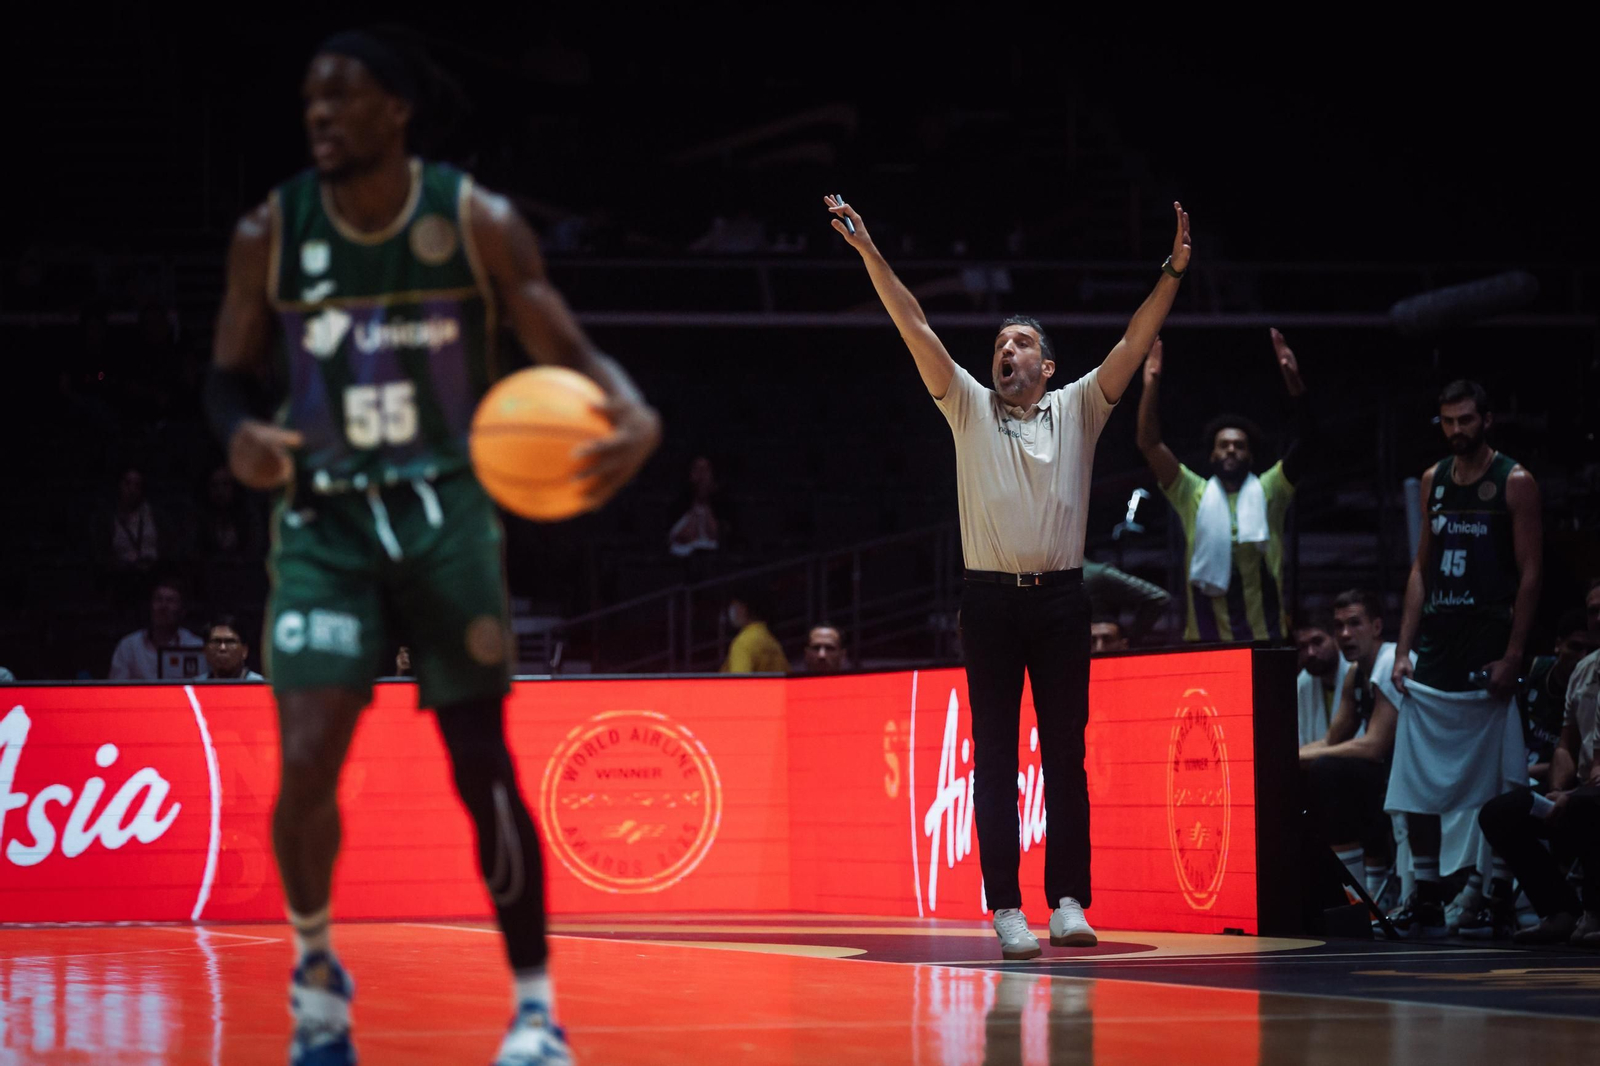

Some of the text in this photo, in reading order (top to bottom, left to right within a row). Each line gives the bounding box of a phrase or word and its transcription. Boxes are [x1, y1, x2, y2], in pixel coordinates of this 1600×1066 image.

[342, 380, 418, 450] 55
[1447, 521, 1488, 537] Unicaja
[1440, 550, 1467, 577] 45
[561, 726, 699, 783] WORLD AIRLINE
[594, 766, 663, 780] WINNER
